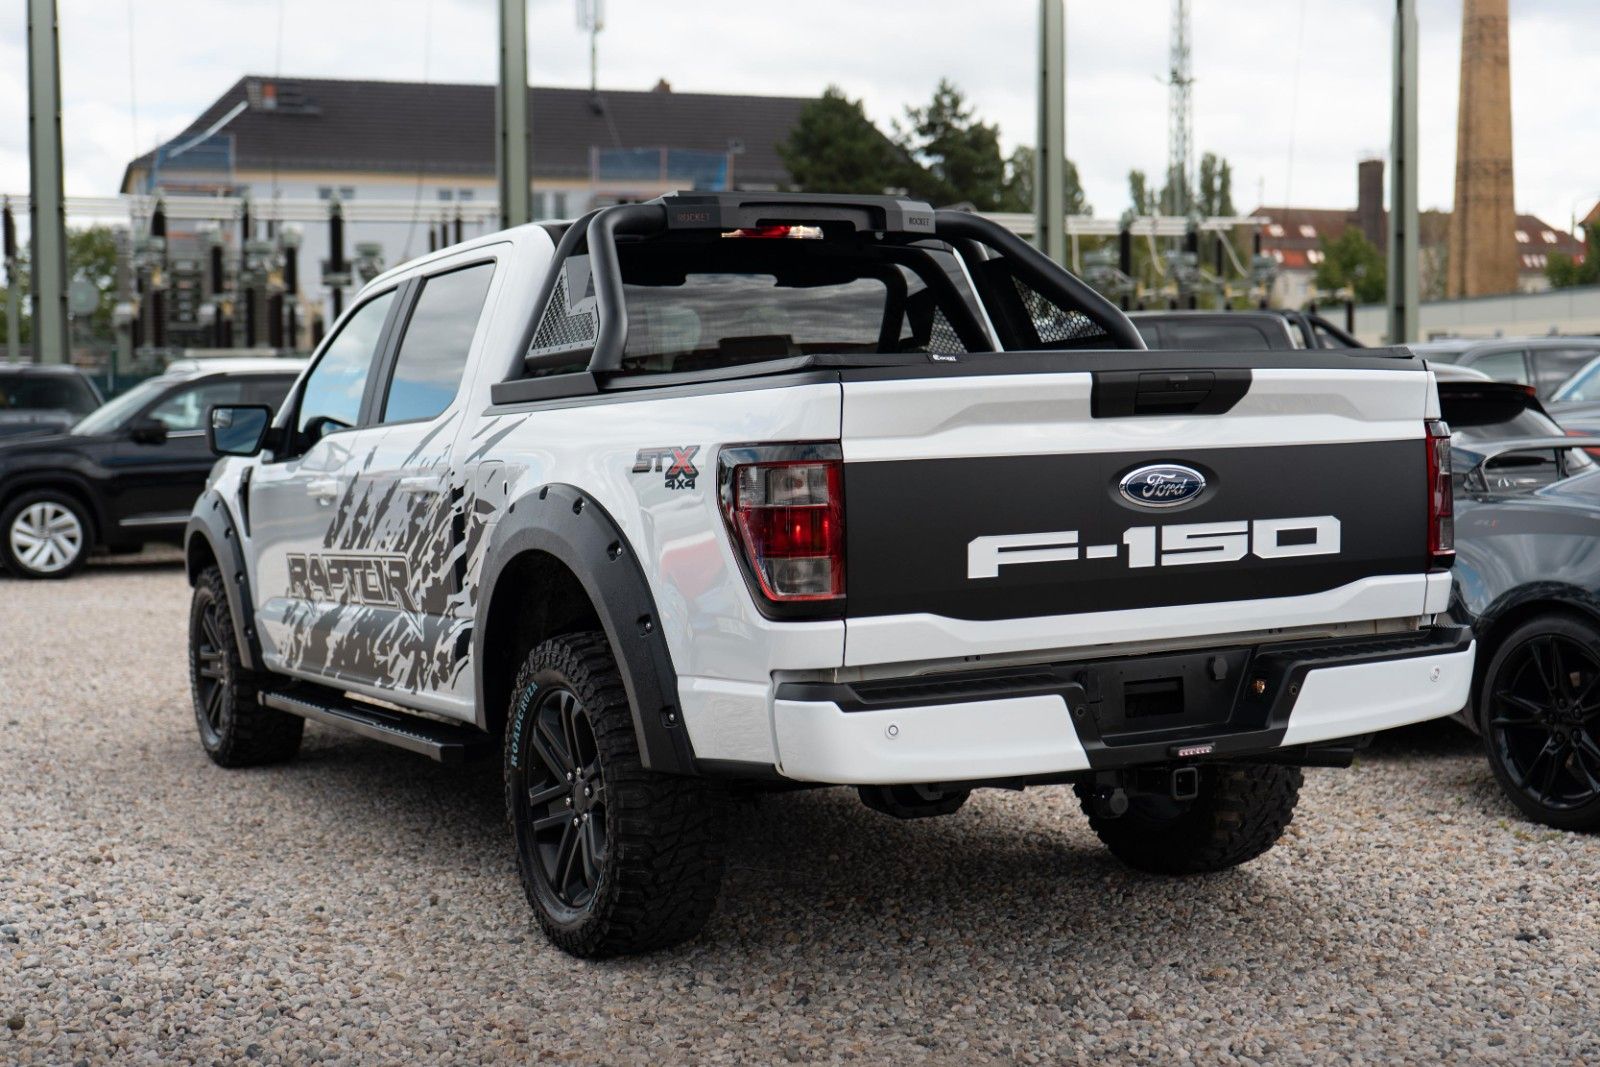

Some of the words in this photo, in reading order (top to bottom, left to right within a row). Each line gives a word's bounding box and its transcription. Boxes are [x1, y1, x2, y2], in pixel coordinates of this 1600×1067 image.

[632, 445, 700, 479] STX
[1142, 473, 1187, 498] Ford
[967, 515, 1341, 579] F-150
[286, 553, 418, 612] RAPTOR
[511, 681, 538, 767] ROADCRUZA
